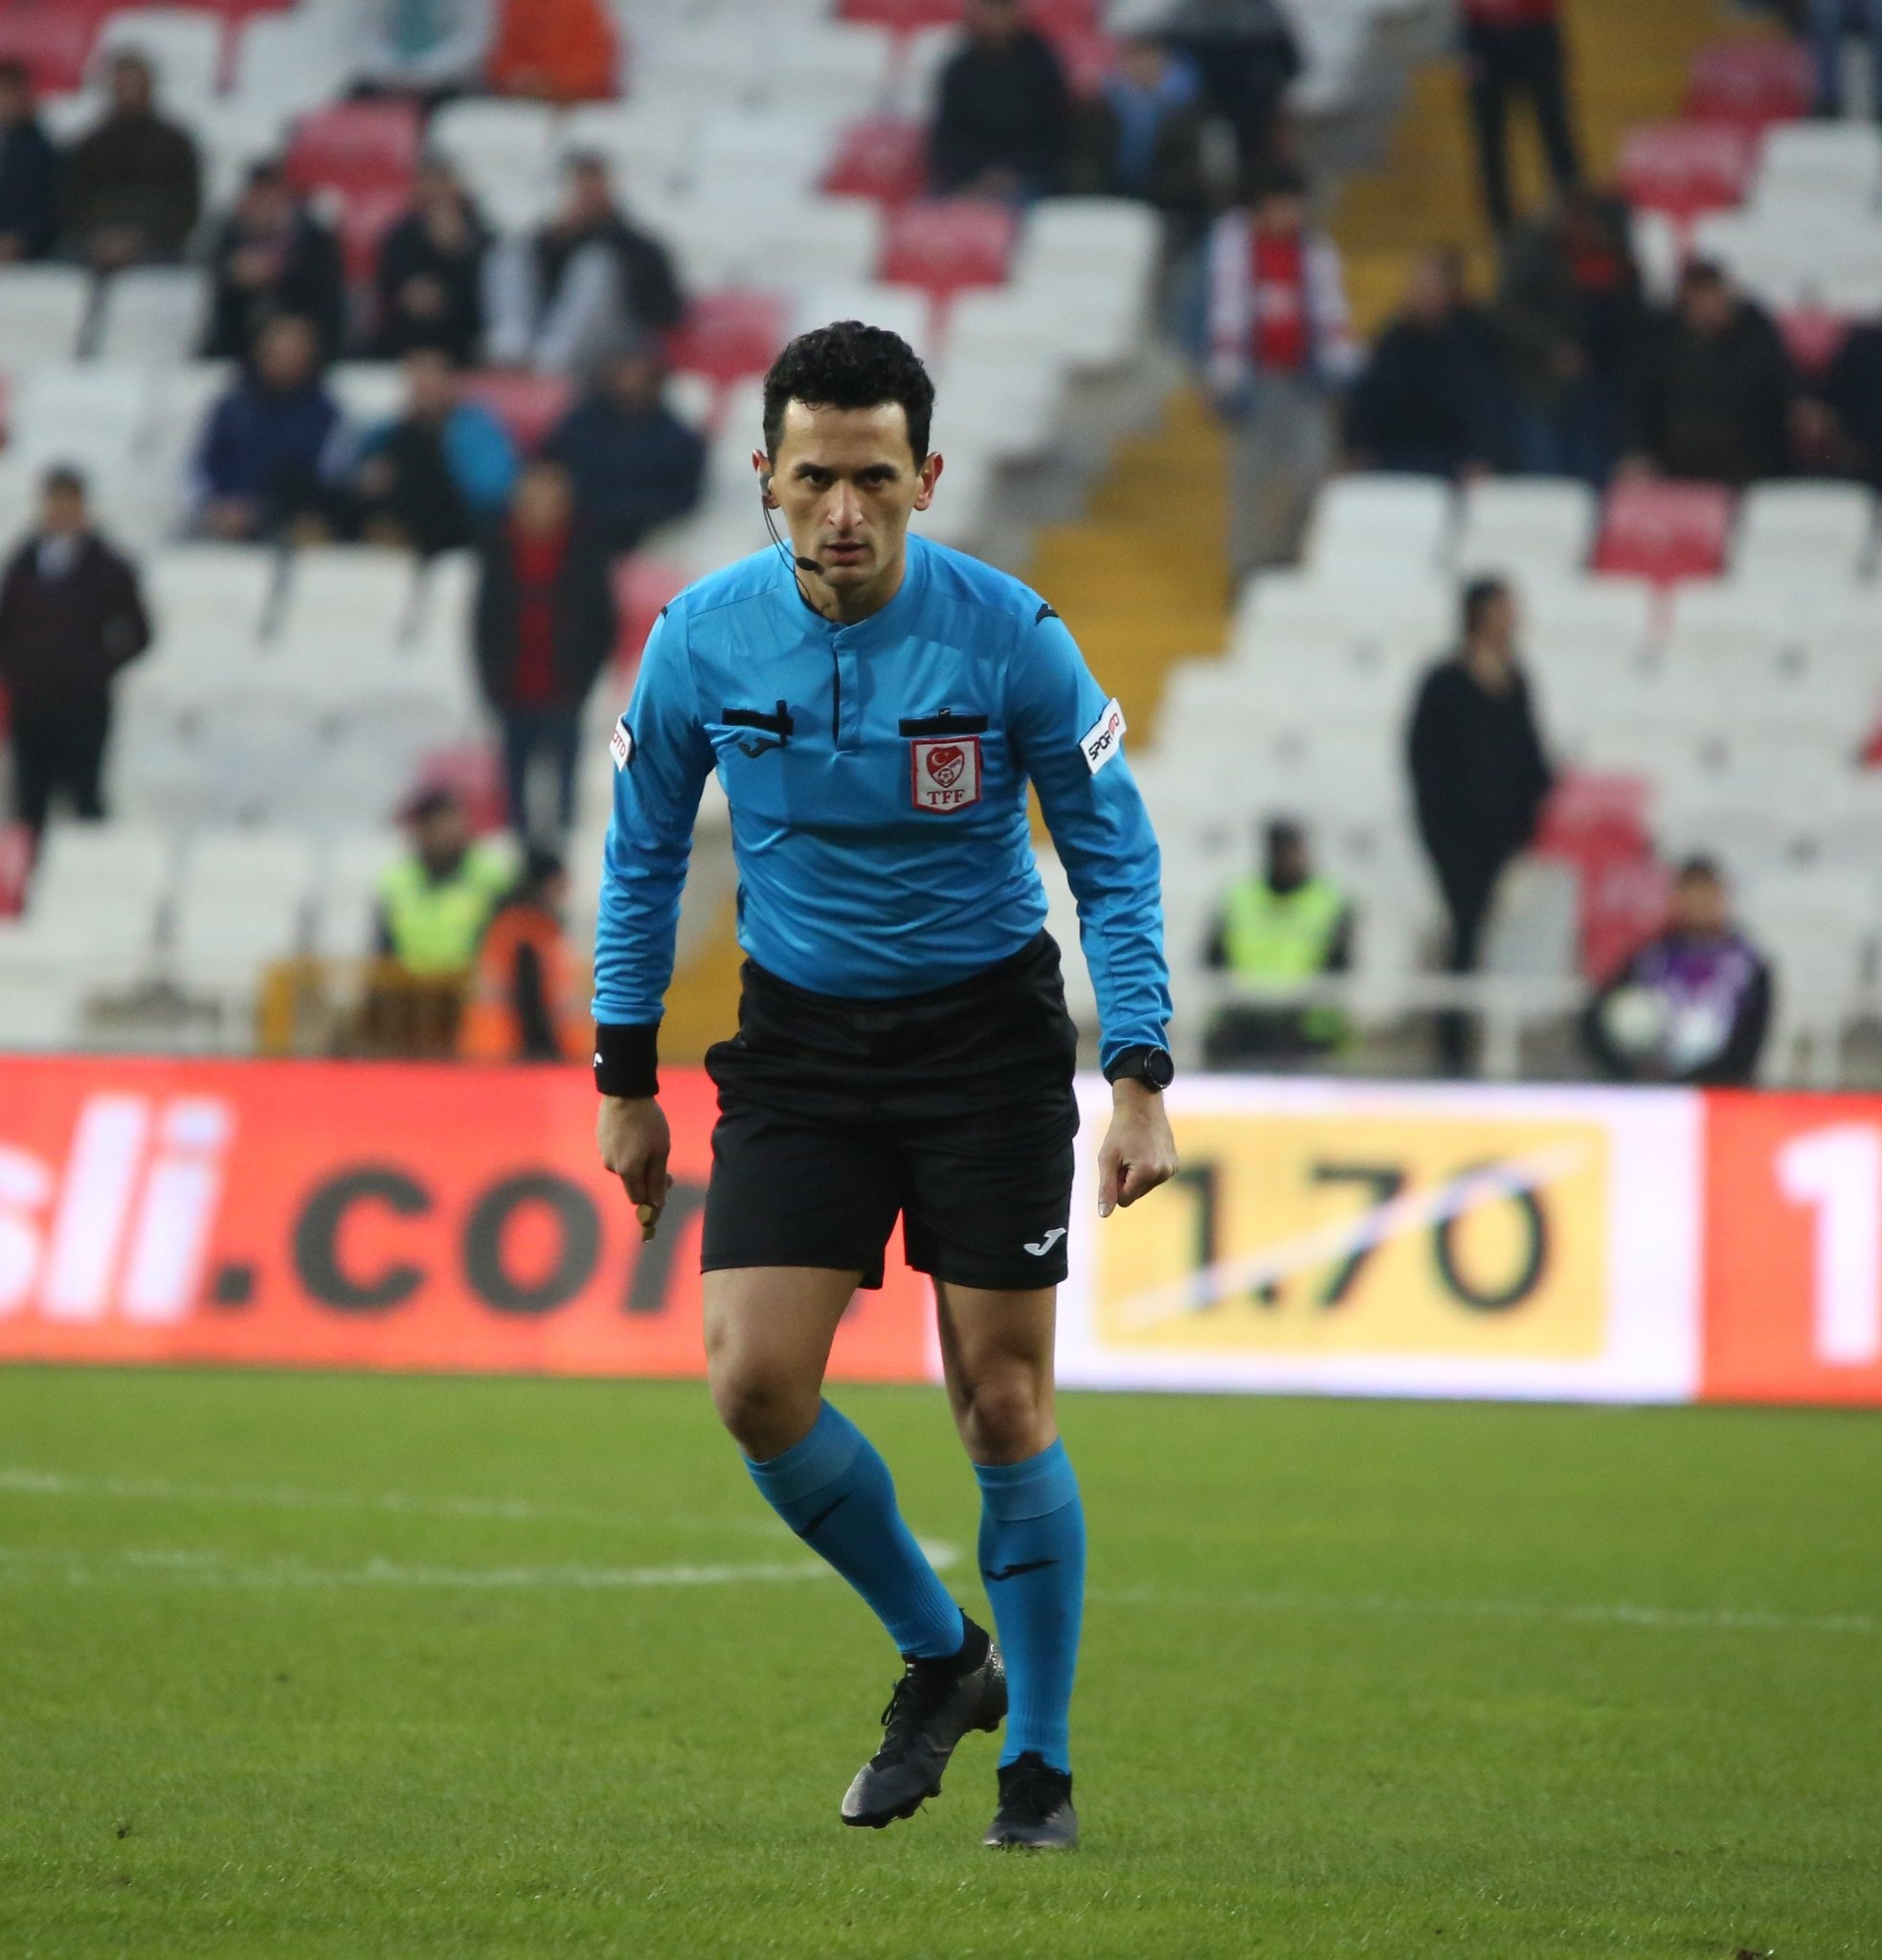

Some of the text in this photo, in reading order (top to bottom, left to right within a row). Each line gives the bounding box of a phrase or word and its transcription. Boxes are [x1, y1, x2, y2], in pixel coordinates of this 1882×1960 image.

[928, 790, 965, 804] TFF
[1176, 1158, 1553, 1313] 1.70
[1772, 1122, 1882, 1367] 1
